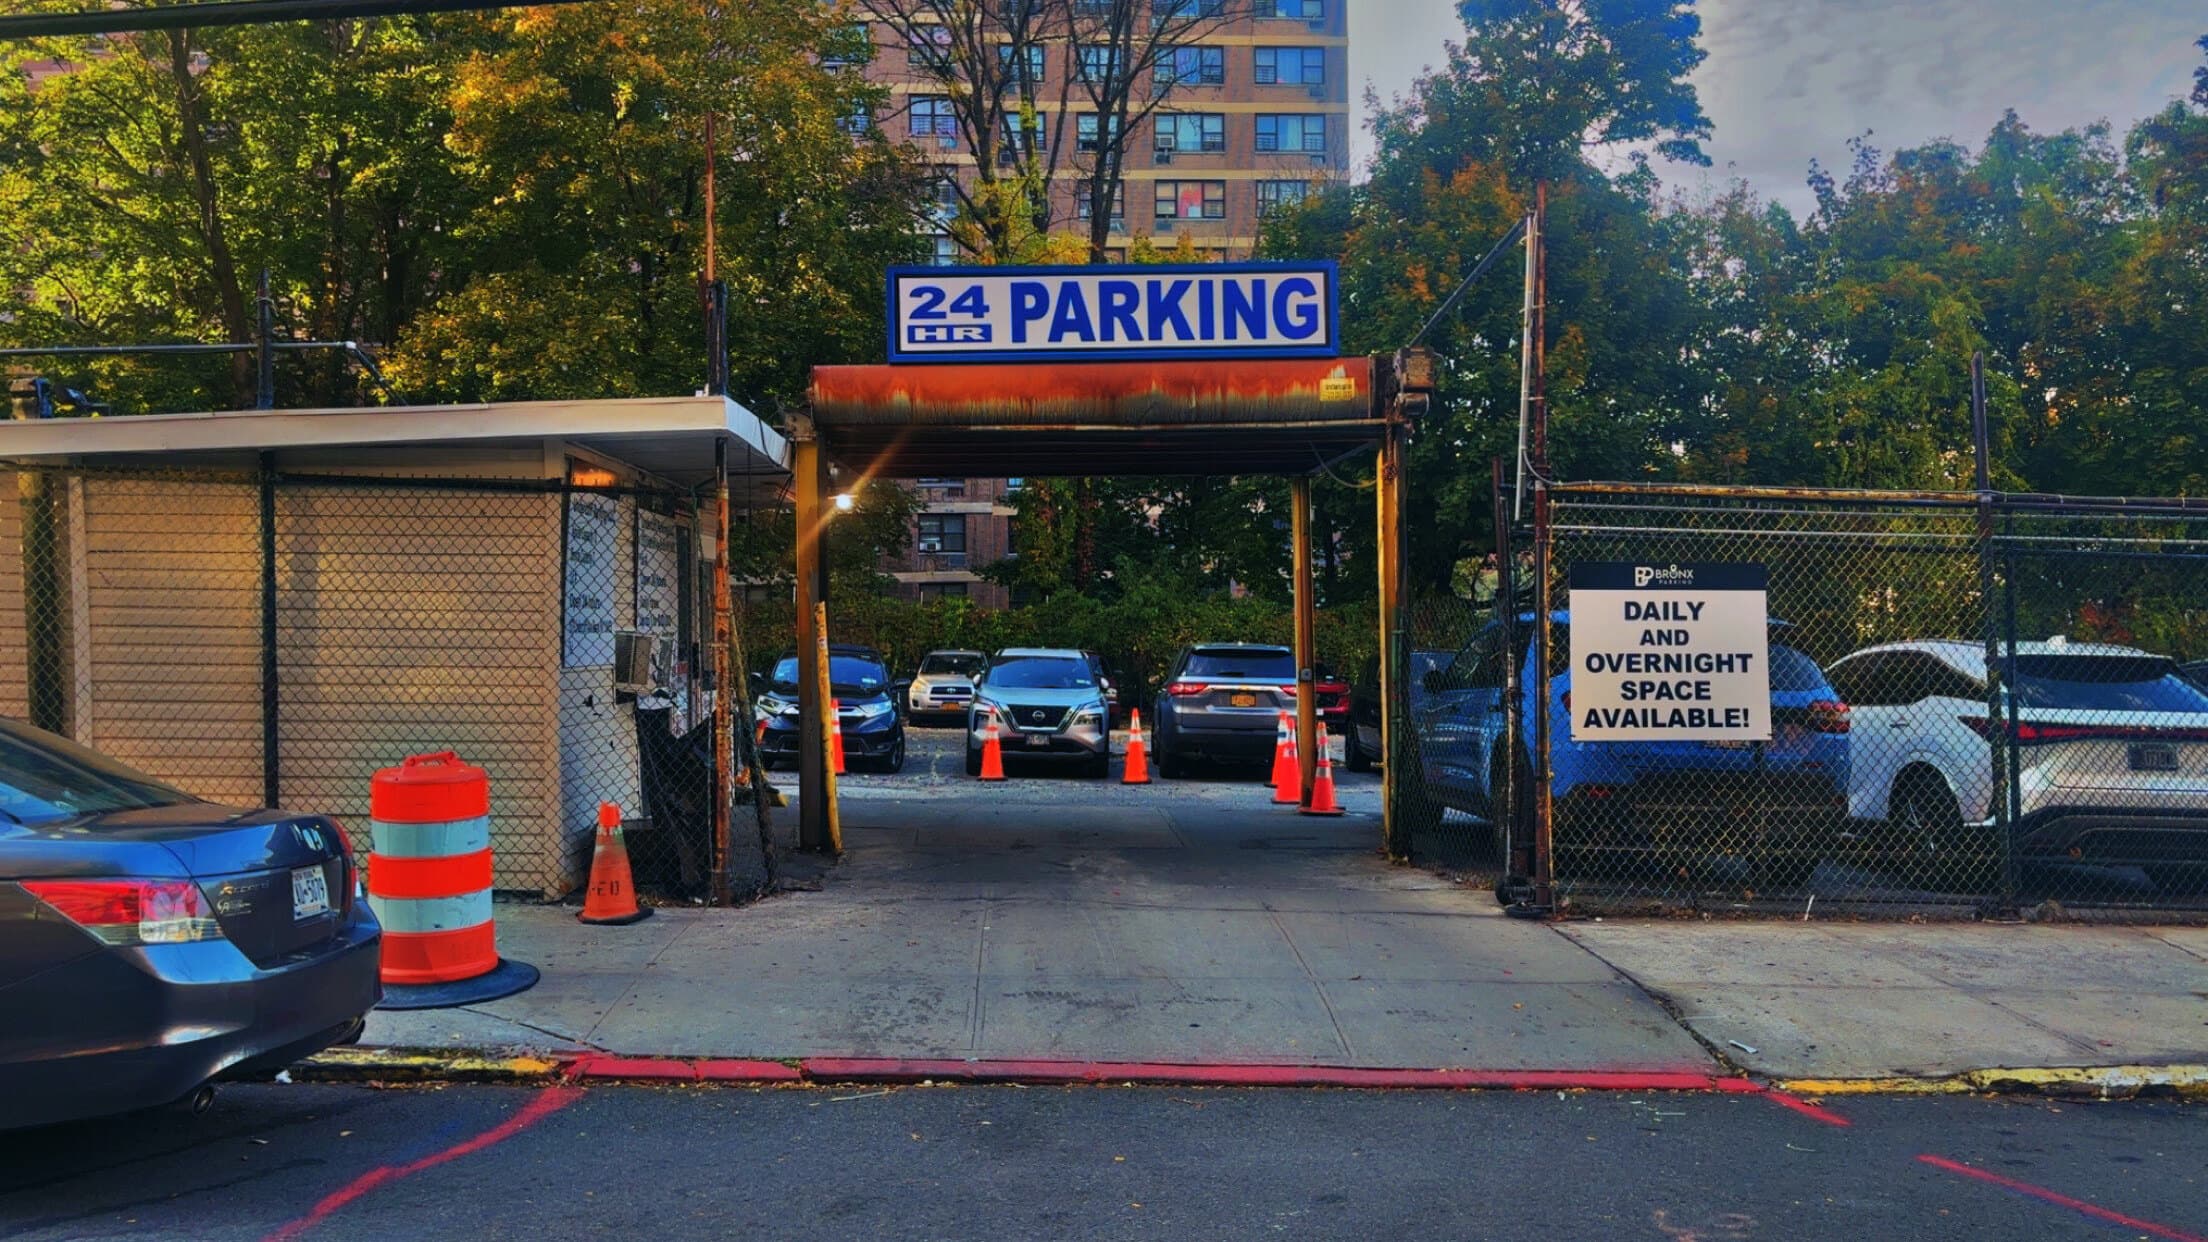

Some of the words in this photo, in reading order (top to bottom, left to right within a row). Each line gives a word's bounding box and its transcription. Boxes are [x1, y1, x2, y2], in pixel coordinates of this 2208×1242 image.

[909, 285, 989, 319] 24
[1010, 277, 1318, 343] PARKING
[914, 327, 985, 341] HR
[1655, 565, 1694, 579] BRONX
[1624, 601, 1705, 621] DAILY
[1640, 629, 1689, 646] AND
[1585, 653, 1753, 673] OVERNIGHT
[1620, 681, 1711, 701] SPACE
[1583, 708, 1749, 728] AVAILABLE!
